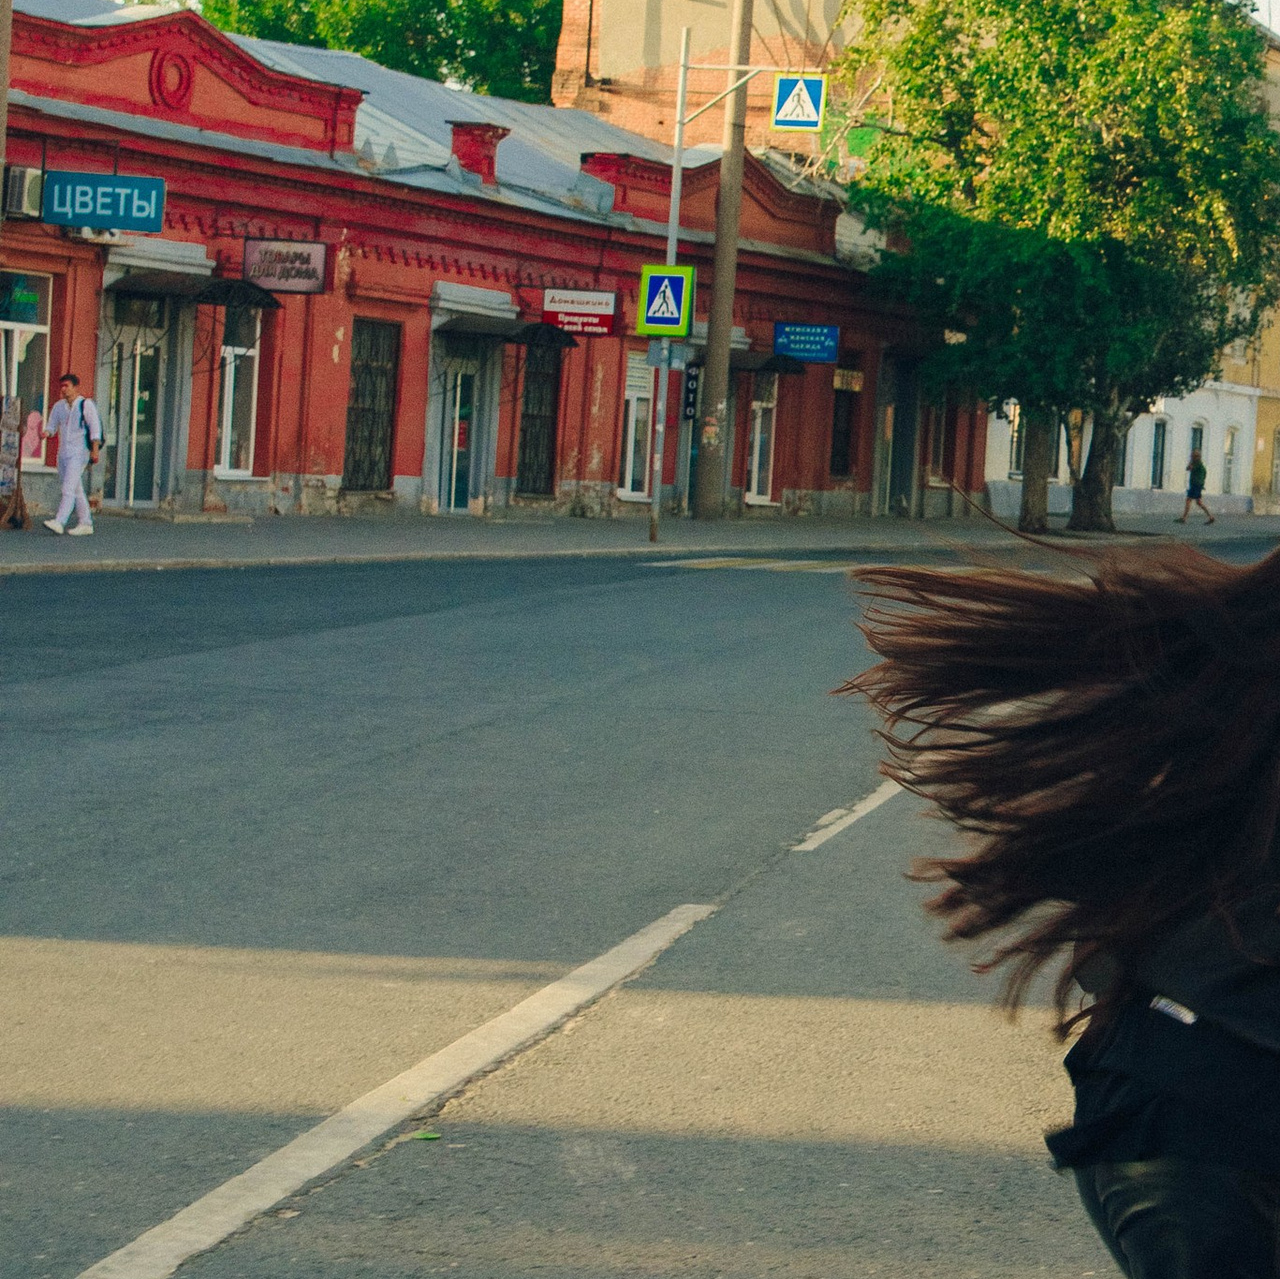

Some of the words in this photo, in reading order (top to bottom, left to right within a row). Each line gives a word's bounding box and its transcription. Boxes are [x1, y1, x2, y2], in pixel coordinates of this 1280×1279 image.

[53, 184, 156, 219] ЦВЕТЫ
[259, 249, 312, 265] ТОВАРЫ
[686, 367, 699, 416] ФОТО
